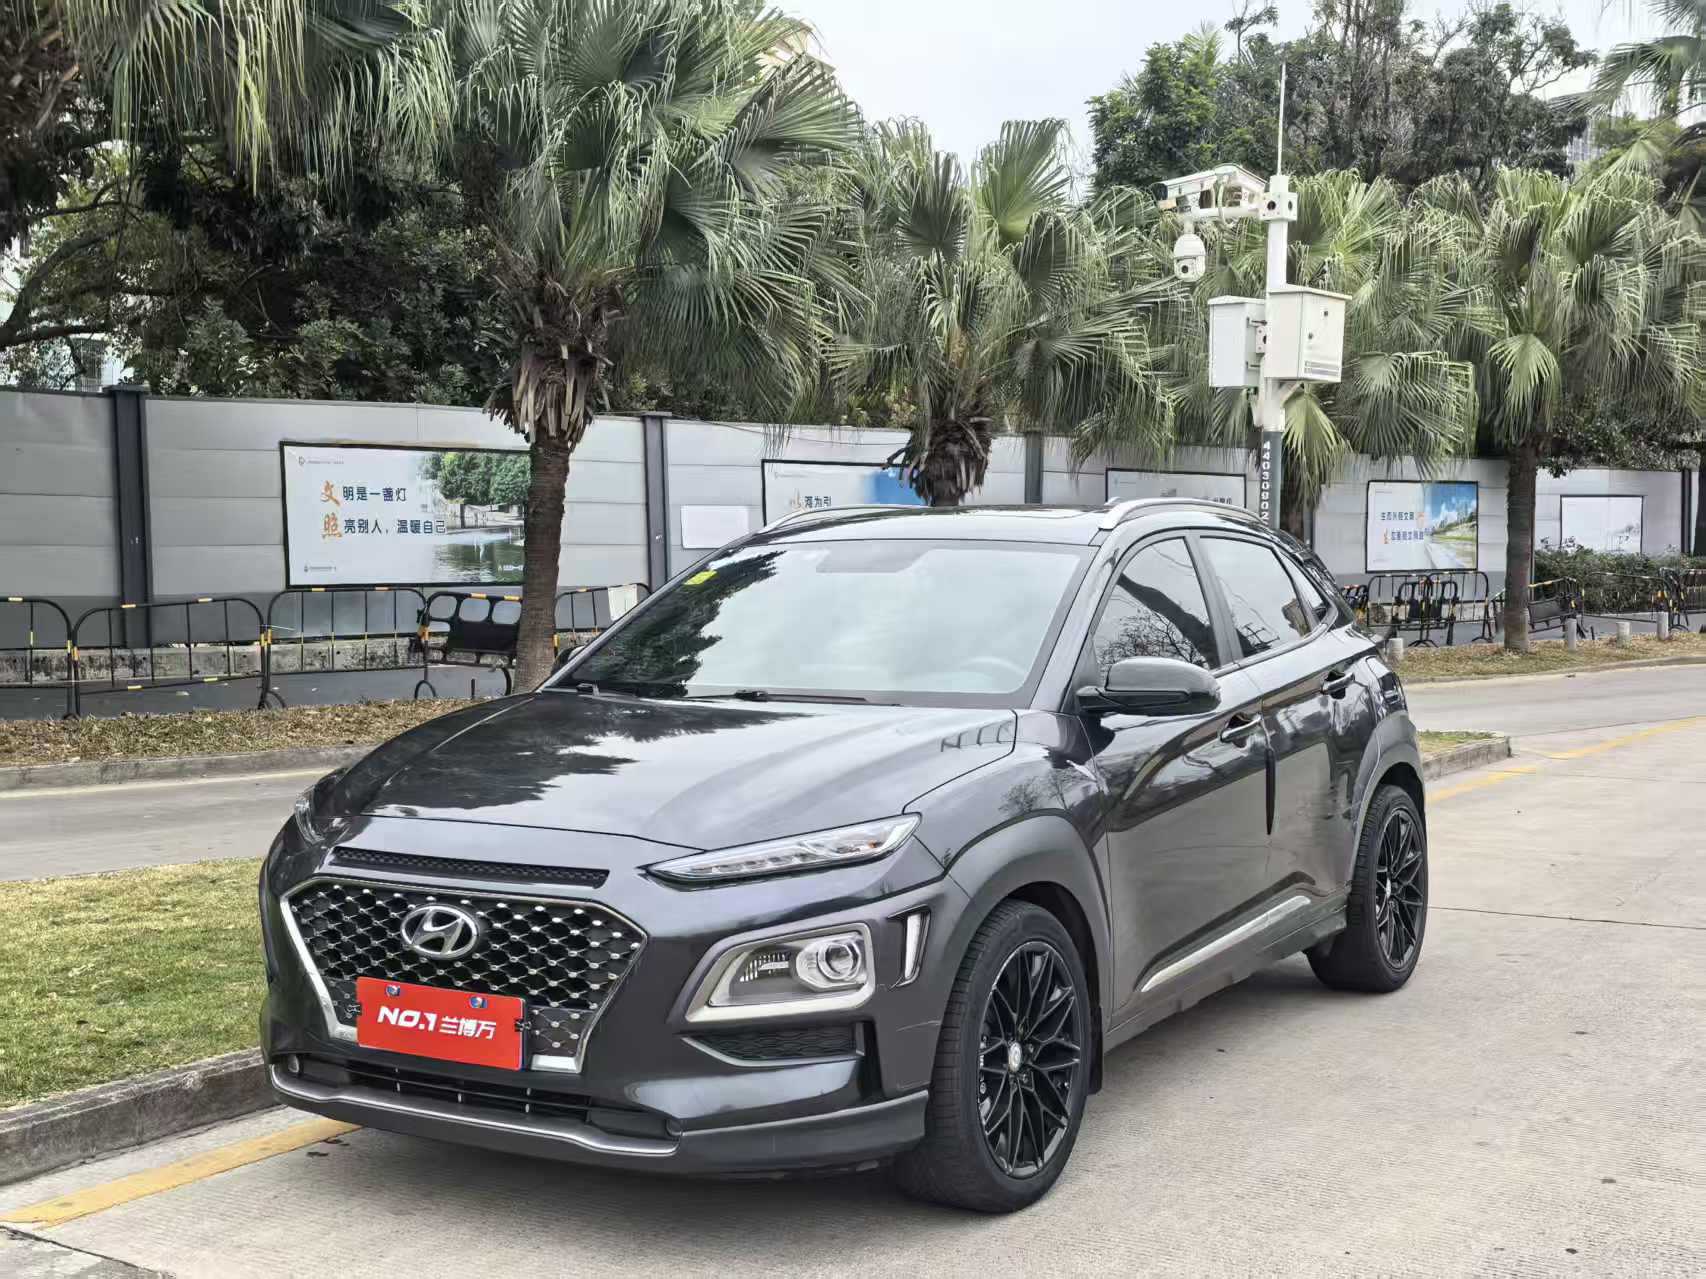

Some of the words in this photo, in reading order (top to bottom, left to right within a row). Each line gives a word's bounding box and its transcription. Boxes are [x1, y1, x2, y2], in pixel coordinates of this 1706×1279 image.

[320, 480, 407, 506] 文明是一盏灯
[321, 512, 446, 539] 照亮别人，温暖自己
[377, 1005, 437, 1032] NO.1
[439, 1015, 497, 1040] 兰博万
